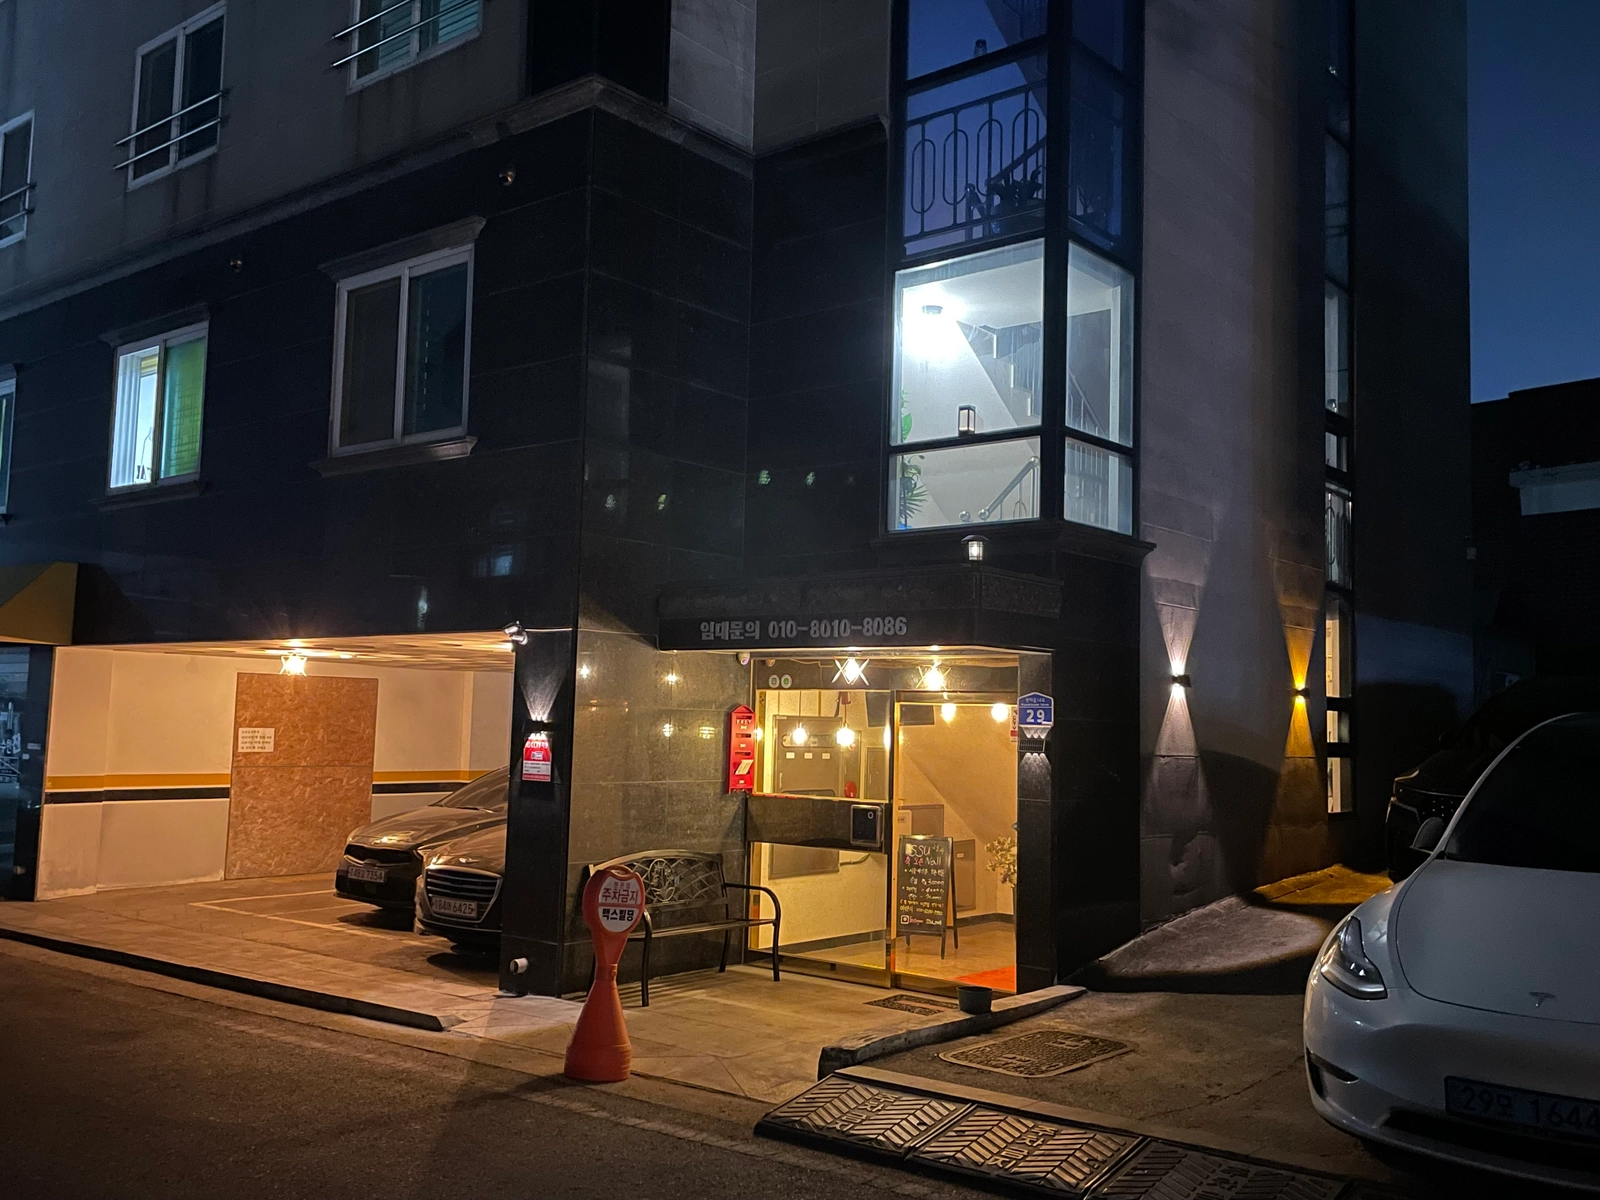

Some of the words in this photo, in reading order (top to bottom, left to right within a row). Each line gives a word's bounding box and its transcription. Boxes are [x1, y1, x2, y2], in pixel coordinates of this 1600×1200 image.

[700, 620, 760, 641] 임대문의
[768, 616, 907, 639] 010-8010-8086
[1026, 709, 1046, 723] 29
[602, 887, 639, 904] 주차금지
[452, 901, 473, 915] 6425
[826, 1092, 899, 1132] 주차금지
[986, 1124, 1059, 1171] 주차금지
